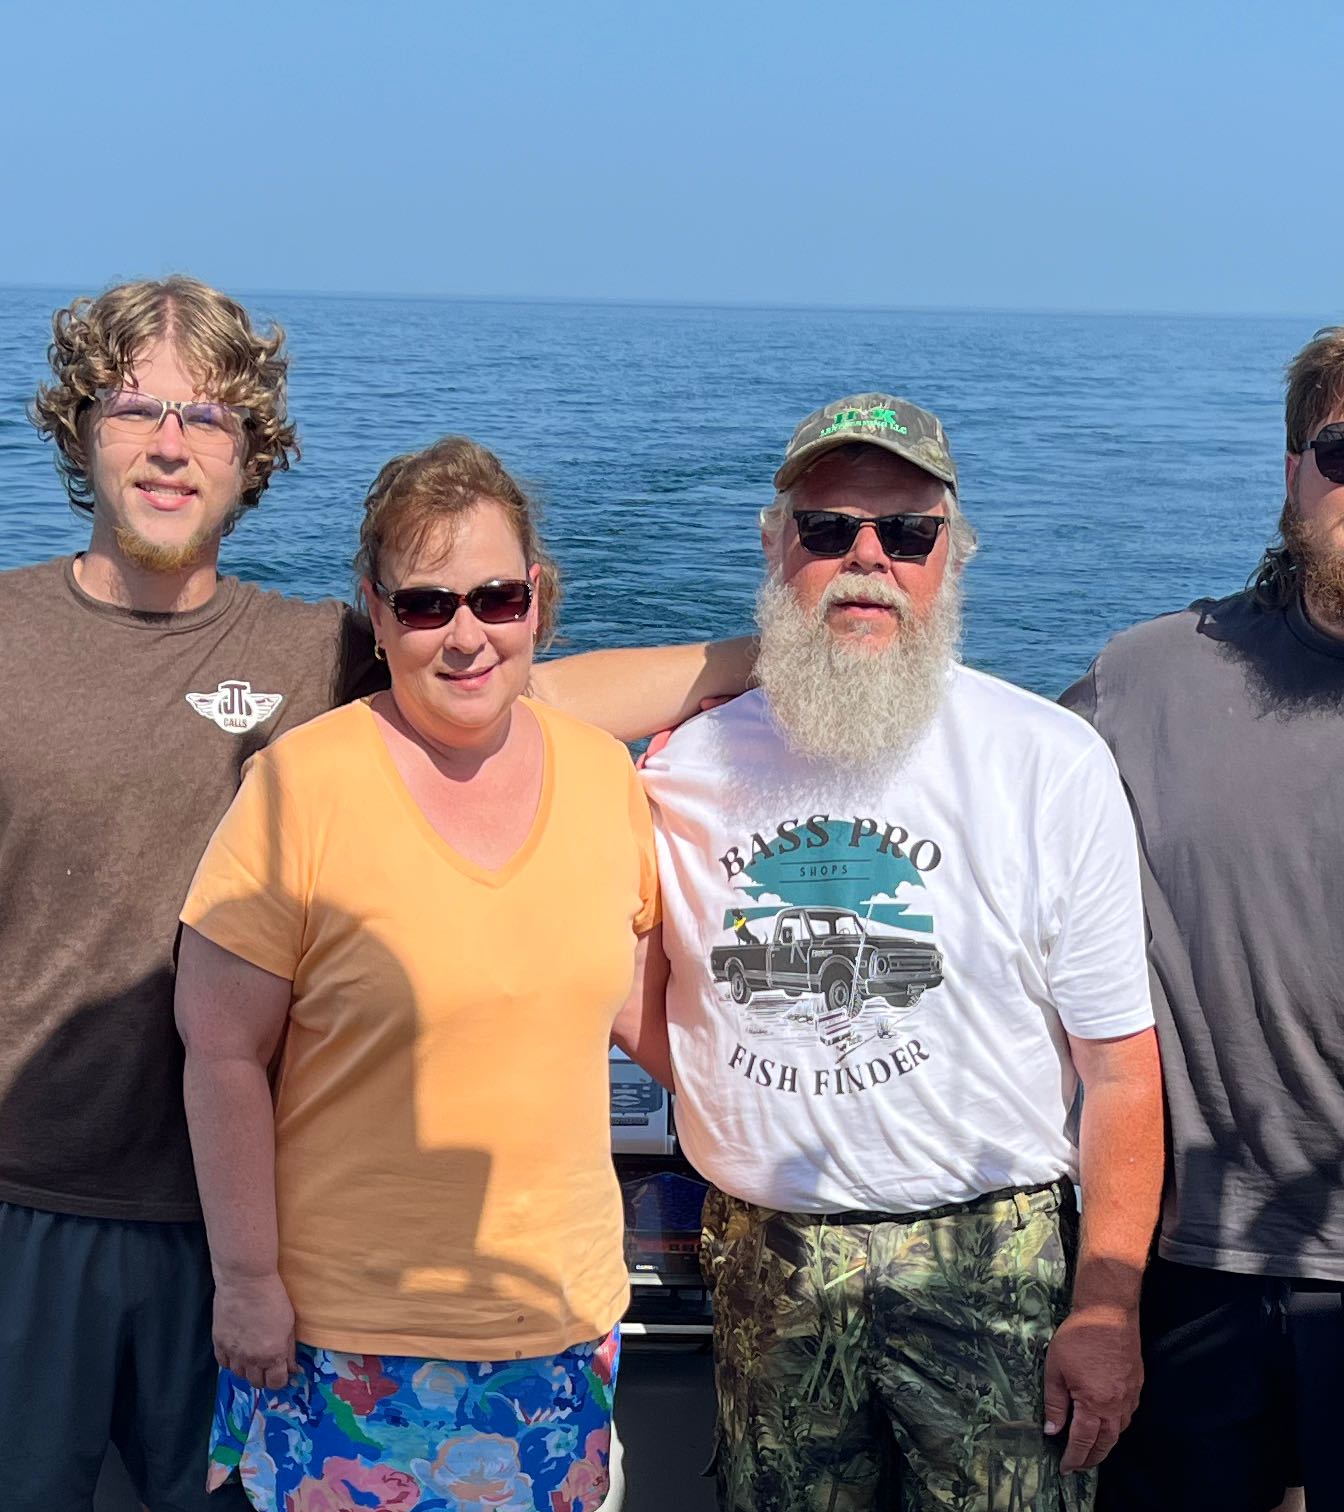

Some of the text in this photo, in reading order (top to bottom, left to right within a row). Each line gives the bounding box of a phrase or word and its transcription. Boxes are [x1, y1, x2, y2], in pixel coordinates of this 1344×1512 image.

[223, 717, 248, 729] CALLS
[718, 813, 942, 881] BASS PRO
[799, 864, 848, 878] SHOPS
[728, 1039, 931, 1095] FISH FINDER
